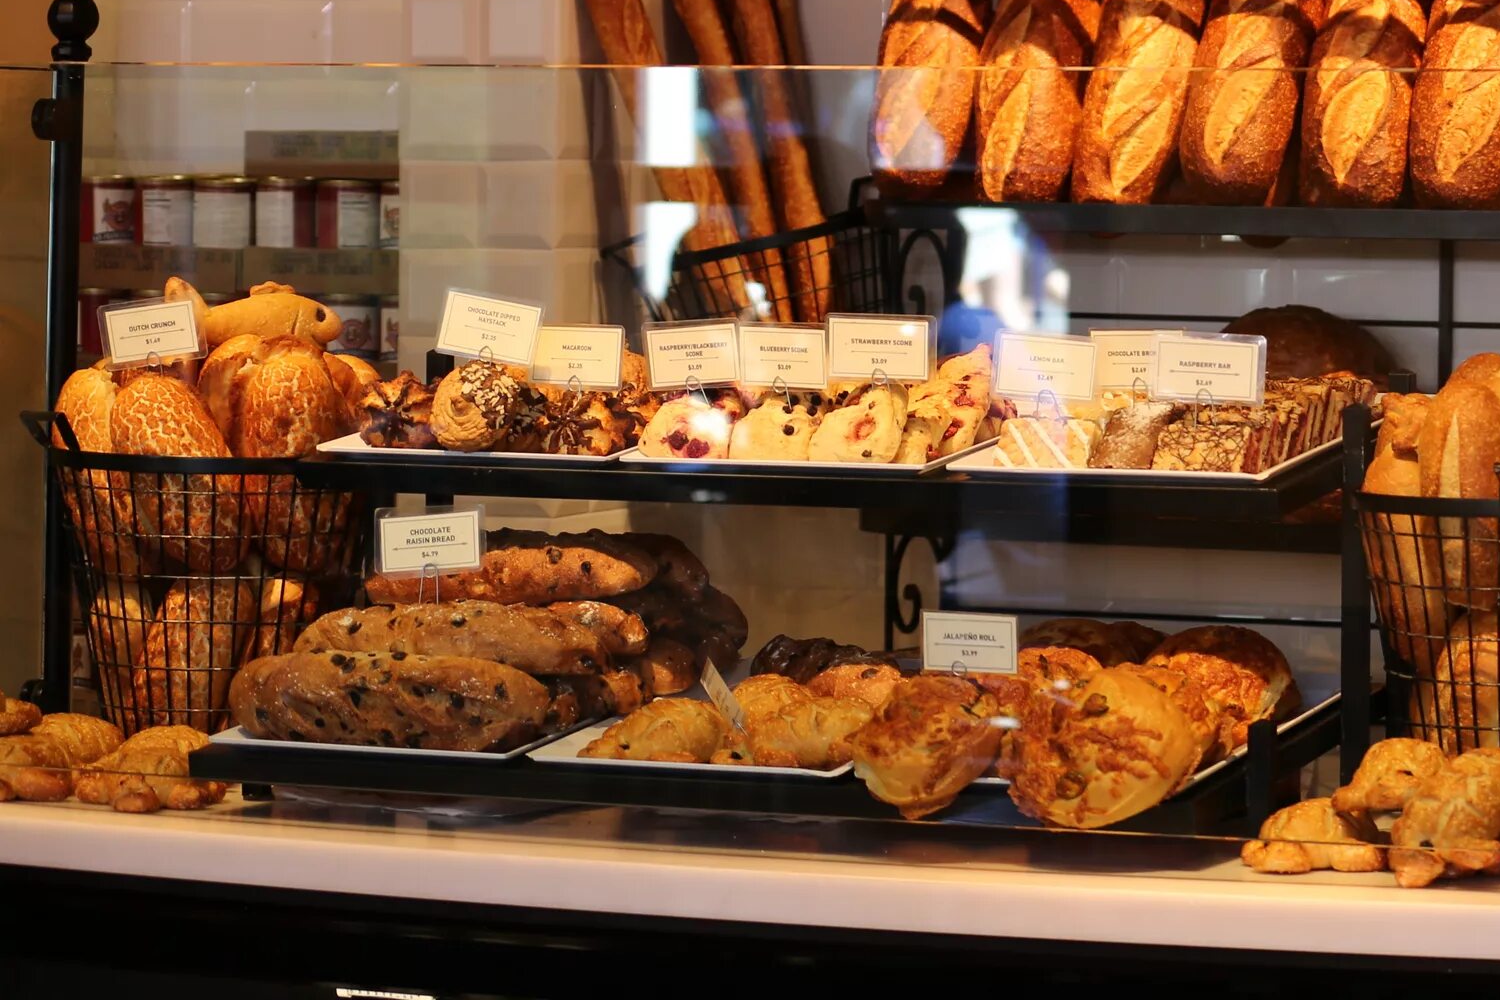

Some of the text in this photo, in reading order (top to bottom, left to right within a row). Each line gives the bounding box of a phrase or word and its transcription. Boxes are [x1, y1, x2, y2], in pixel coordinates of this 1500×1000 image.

[467, 306, 500, 318] CHOCOLATE
[128, 320, 176, 332] DUTCH CRUNCH
[660, 342, 728, 351] RASPBERRY/BLACKBERRY
[851, 338, 892, 346] STRAWBERRY
[562, 344, 592, 352] MACAROON
[791, 346, 808, 354] SCONE
[1179, 360, 1216, 368] RASPBERRY
[410, 526, 451, 536] CHOCOLATE
[406, 535, 456, 546] RAISIN BREAD
[944, 632, 996, 642] JALAPEÑO ROLL
